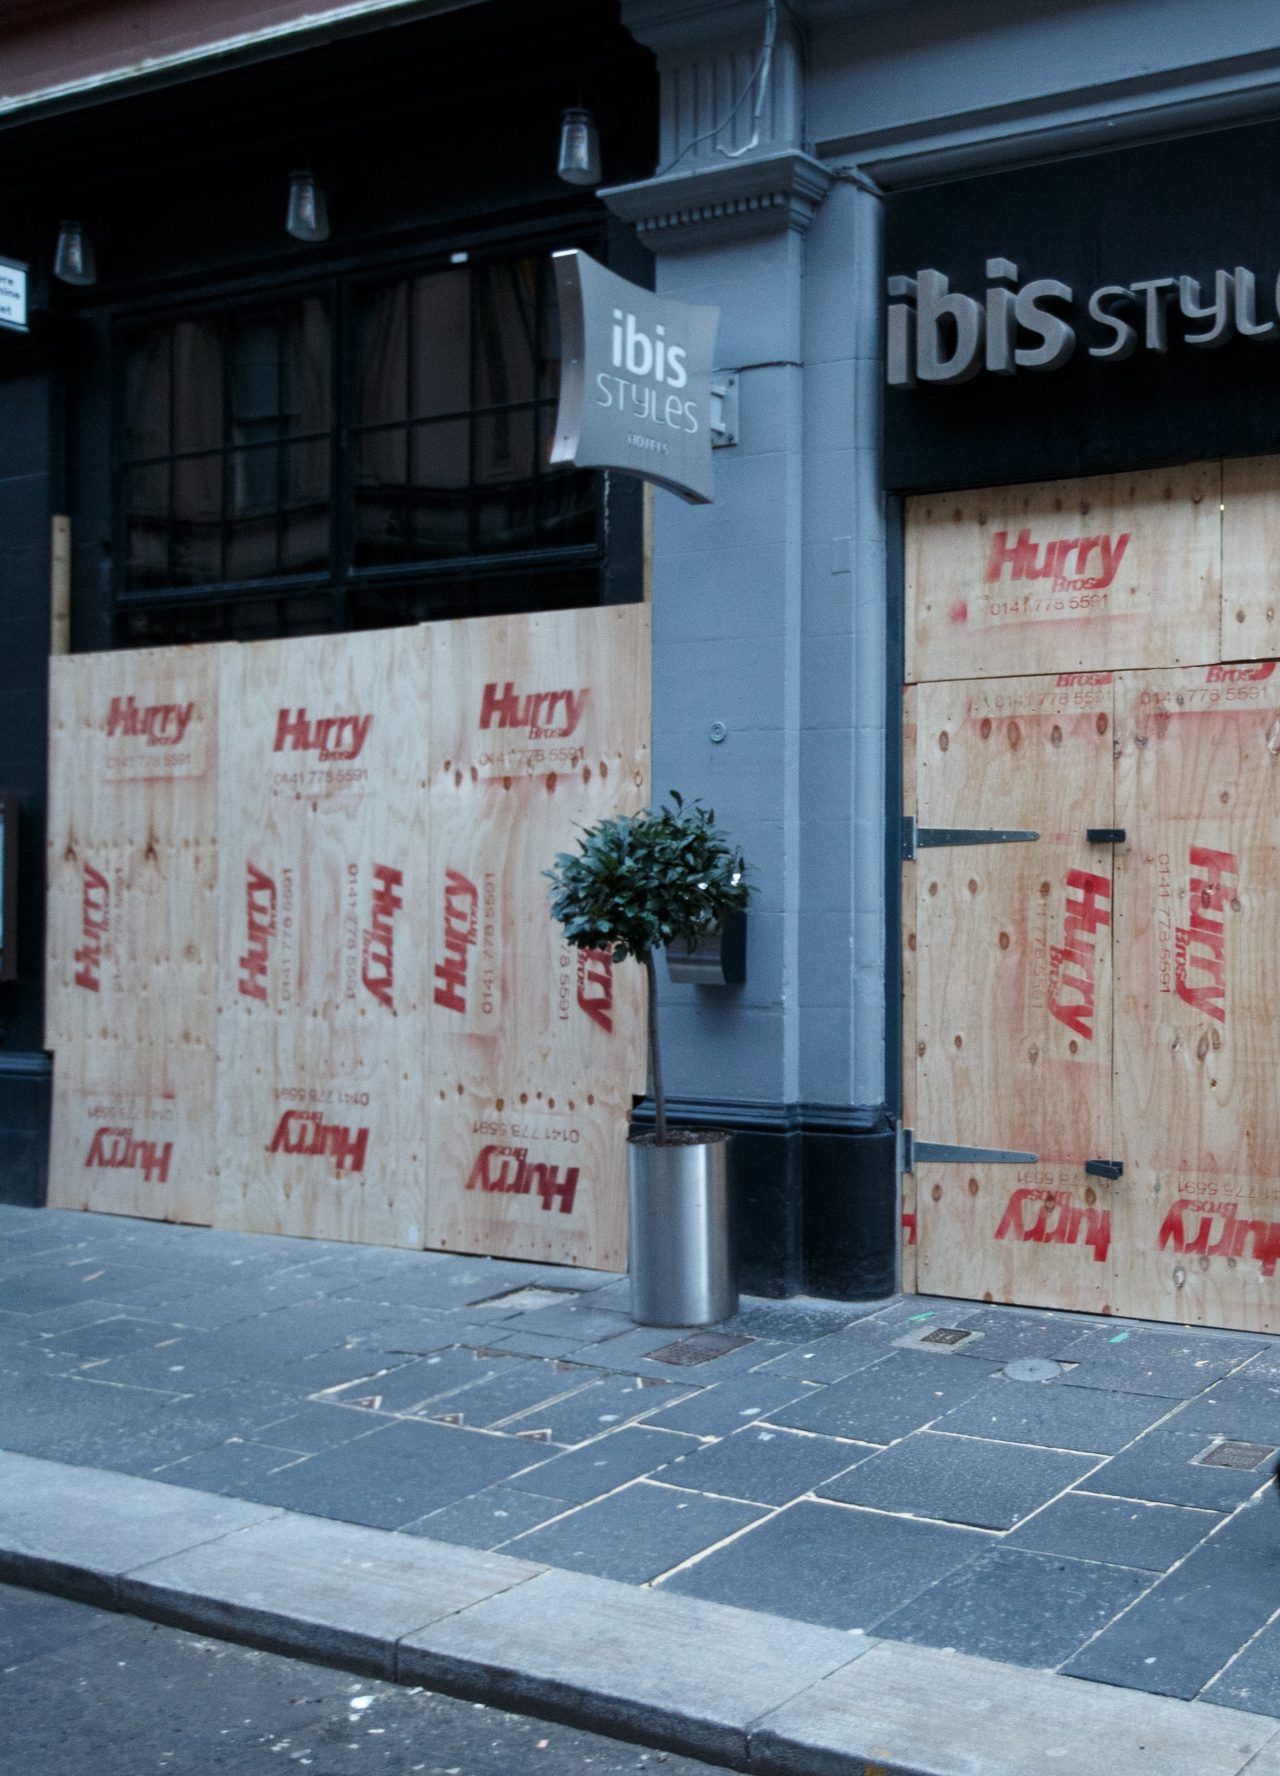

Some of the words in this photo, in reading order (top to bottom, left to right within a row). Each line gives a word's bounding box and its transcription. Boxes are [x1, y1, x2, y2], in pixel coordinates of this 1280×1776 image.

[612, 308, 688, 389] ibis
[887, 256, 1077, 388] ibis
[984, 528, 1131, 589] Hurry
[1052, 576, 1098, 593] Bros
[479, 682, 590, 739] Hurry
[1206, 664, 1254, 683] Bros
[106, 695, 195, 745] Hurry
[273, 707, 374, 760] Hurry
[74, 862, 110, 993] Hurry
[238, 862, 277, 1001] Hurry
[361, 863, 403, 1010] Hurry
[433, 867, 478, 1014] Hurry
[1048, 868, 1112, 1041] Hurry
[1175, 845, 1239, 1025] Hurry
[576, 941, 613, 1033] rry
[84, 1126, 174, 1183] Hurry
[270, 1109, 369, 1172] Hurry
[464, 1144, 580, 1215] Hurry
